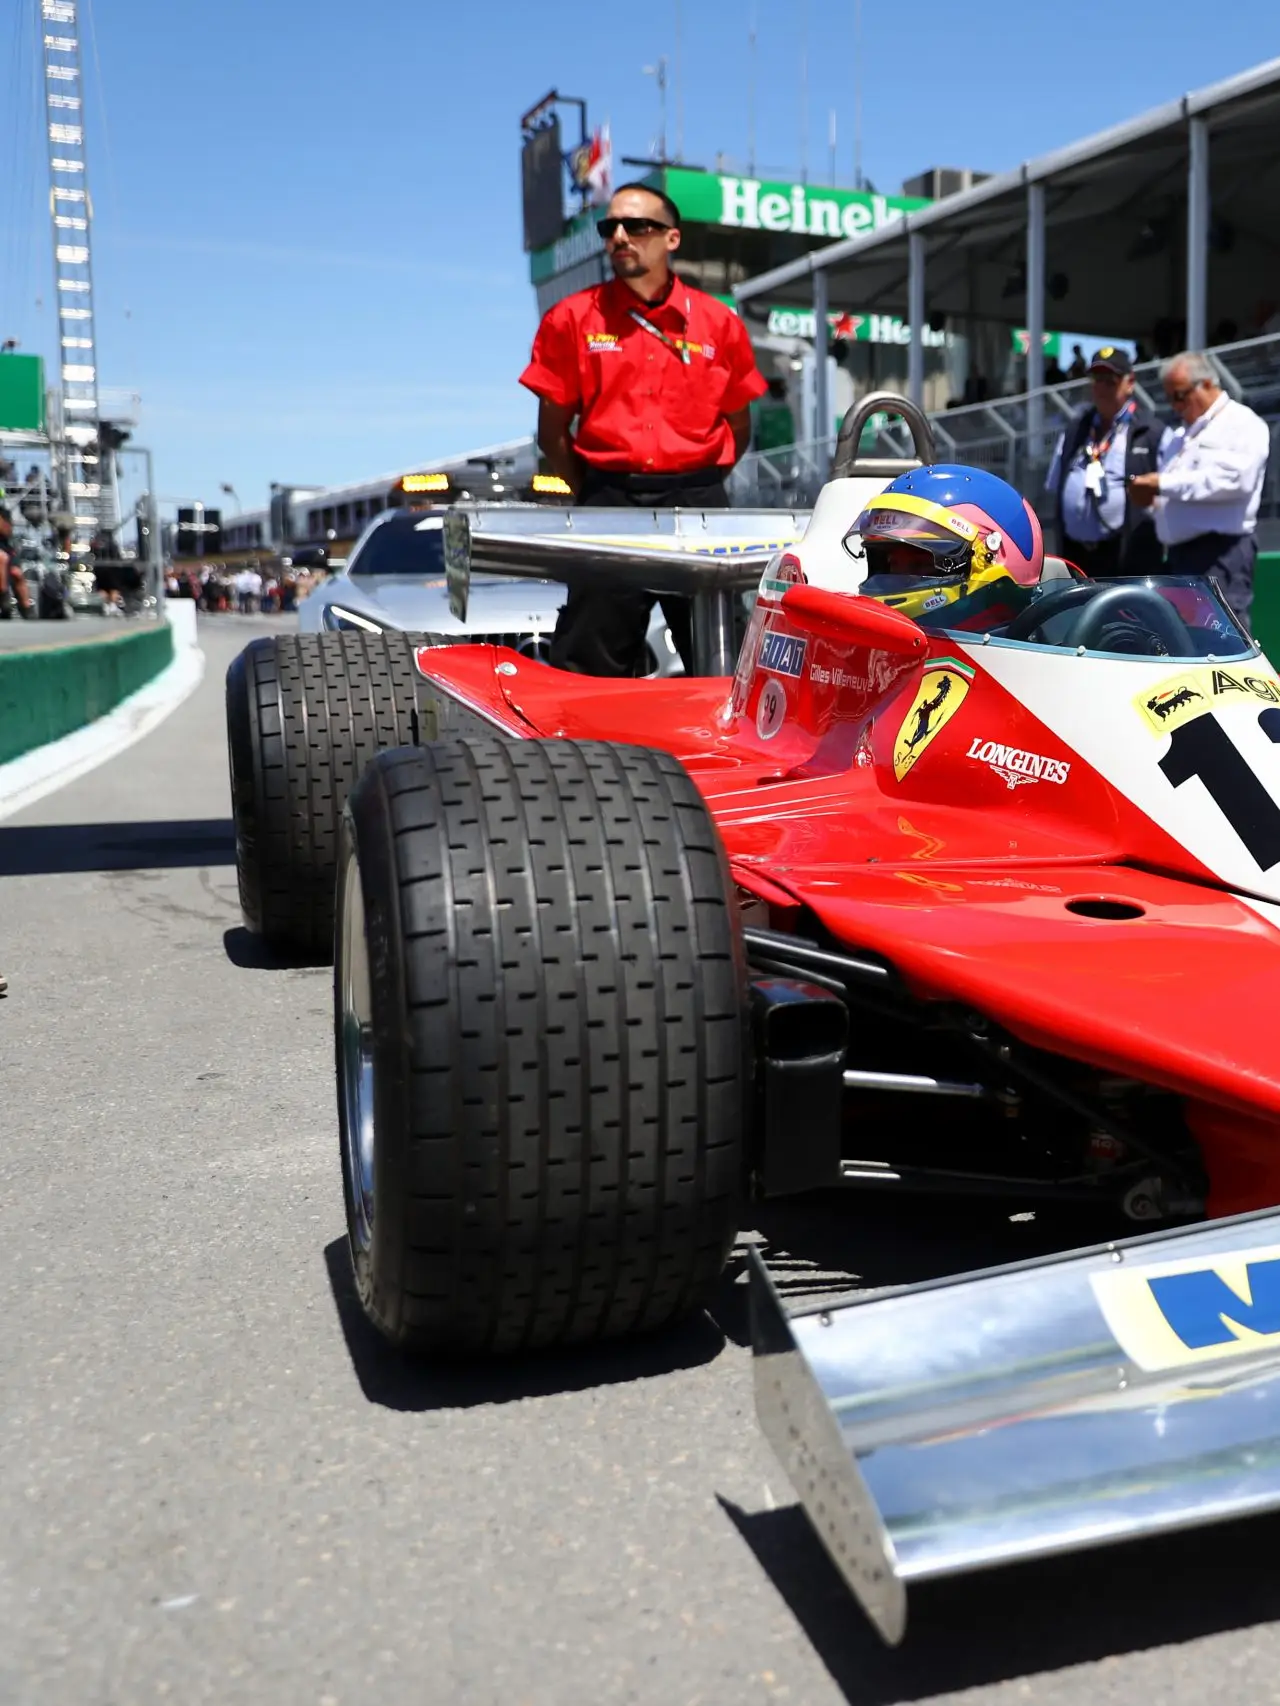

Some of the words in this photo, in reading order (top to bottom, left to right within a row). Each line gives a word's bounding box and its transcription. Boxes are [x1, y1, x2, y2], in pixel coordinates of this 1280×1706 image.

[951, 518, 970, 533] BELL
[925, 597, 945, 609] BELL
[760, 638, 803, 670] FIAT
[810, 664, 830, 684] Gilles
[831, 667, 874, 692] Villeneuve
[966, 737, 1071, 785] LONGINES
